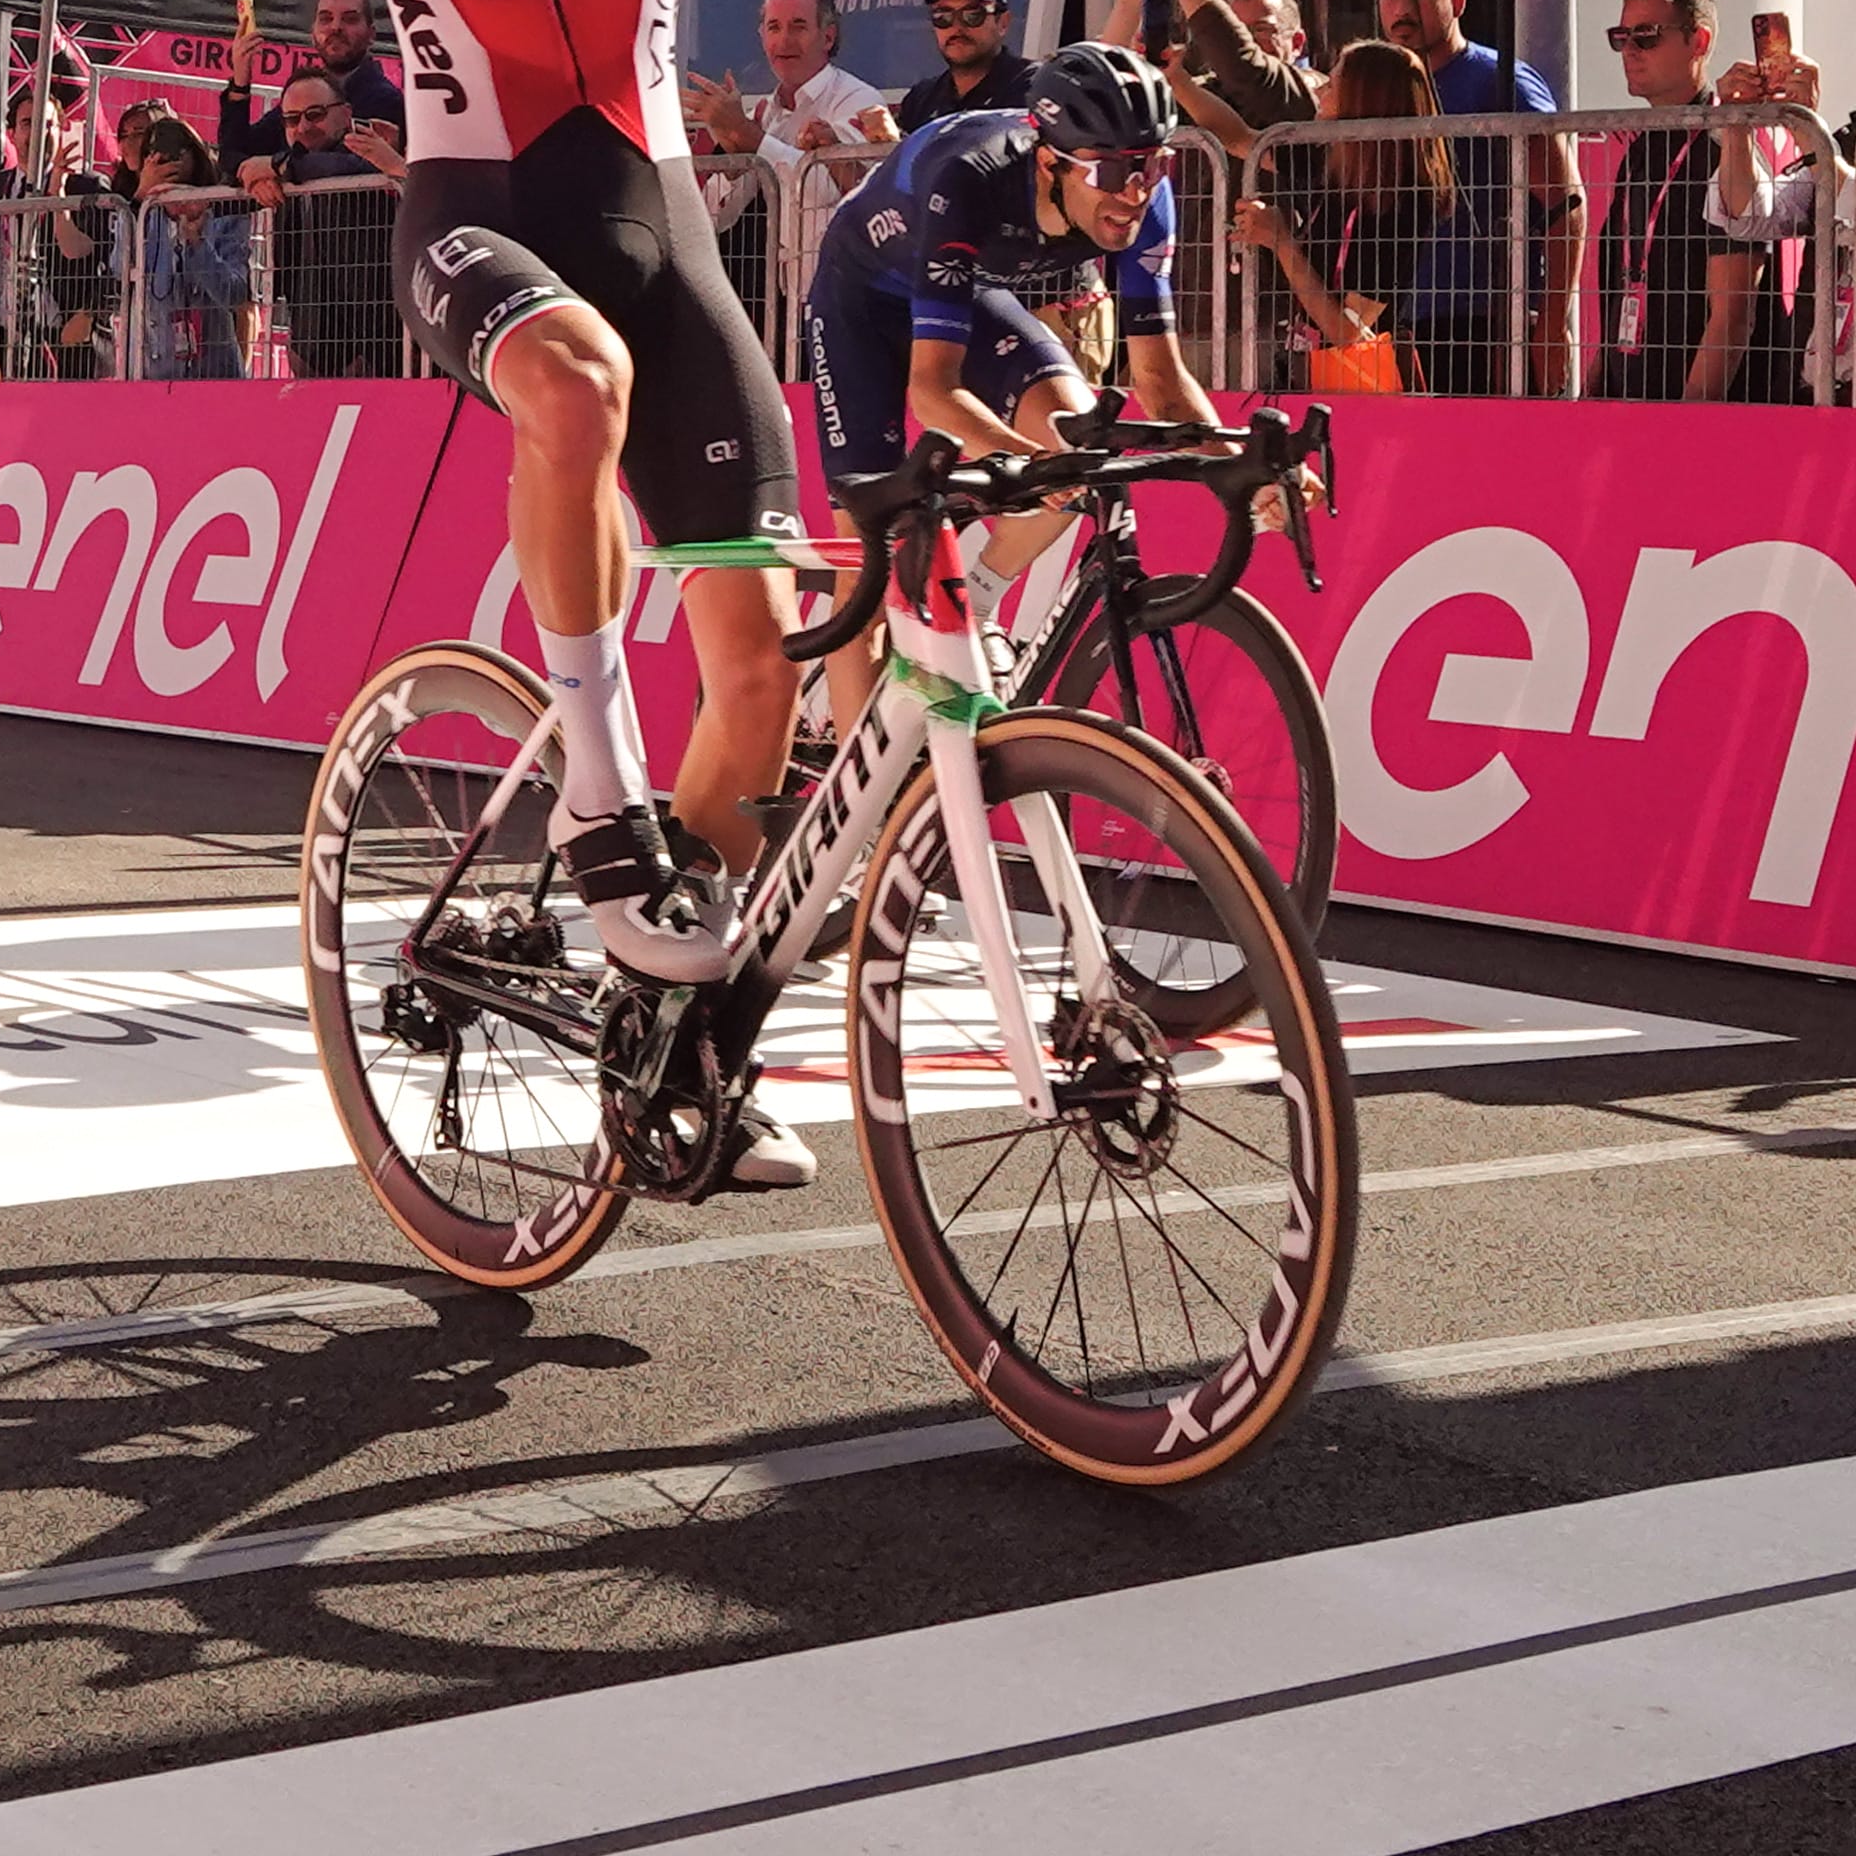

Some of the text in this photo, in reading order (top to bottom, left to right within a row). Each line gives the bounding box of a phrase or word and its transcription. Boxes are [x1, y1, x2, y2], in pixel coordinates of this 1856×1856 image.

[811, 317, 847, 448] Groupama
[309, 677, 420, 974] CADEX
[759, 698, 892, 938] GIANT
[1154, 1069, 1316, 1454] CADEX
